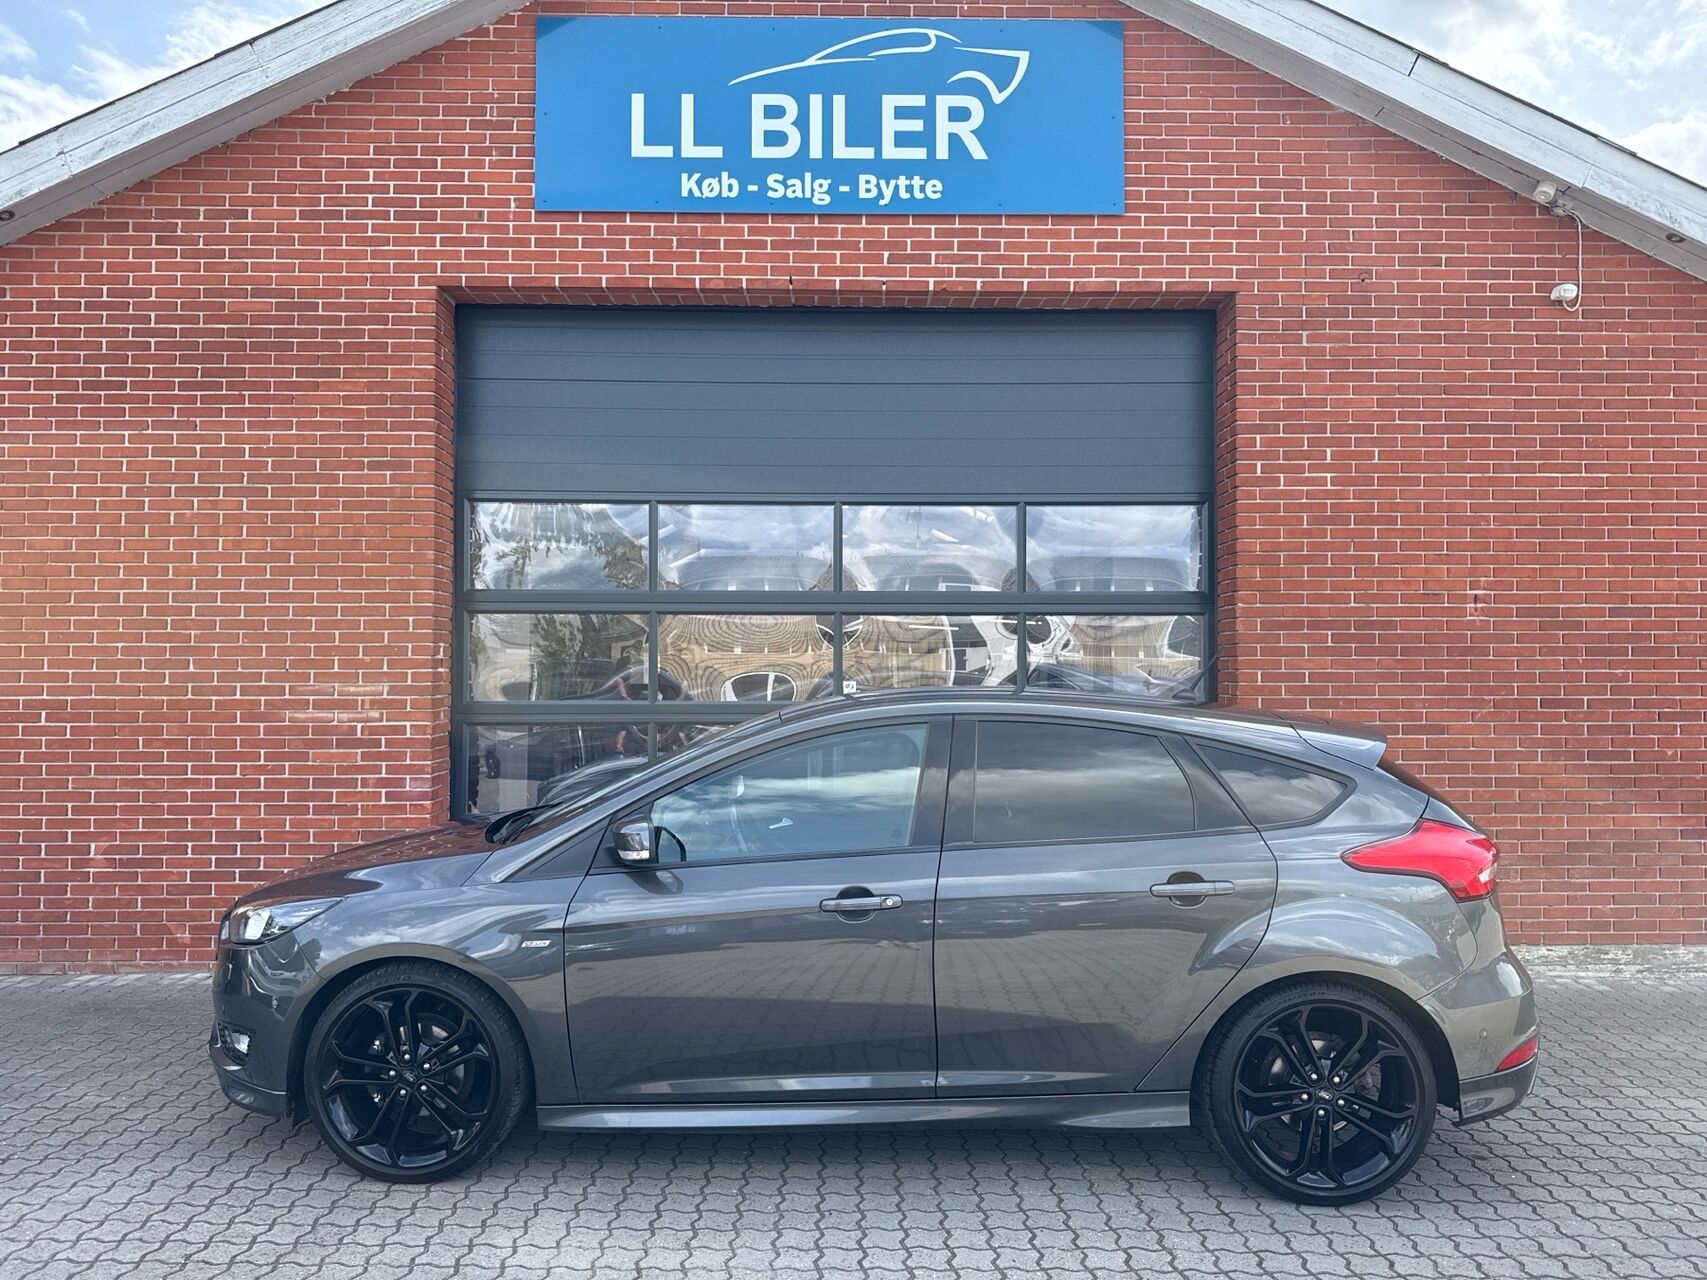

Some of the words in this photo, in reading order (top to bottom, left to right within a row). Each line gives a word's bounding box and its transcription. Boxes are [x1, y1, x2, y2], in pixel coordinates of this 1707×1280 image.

[631, 93, 723, 158] LL
[751, 93, 988, 160] BILER
[680, 172, 739, 198] Køb
[766, 172, 831, 205] Salg
[858, 174, 943, 206] Bytte
